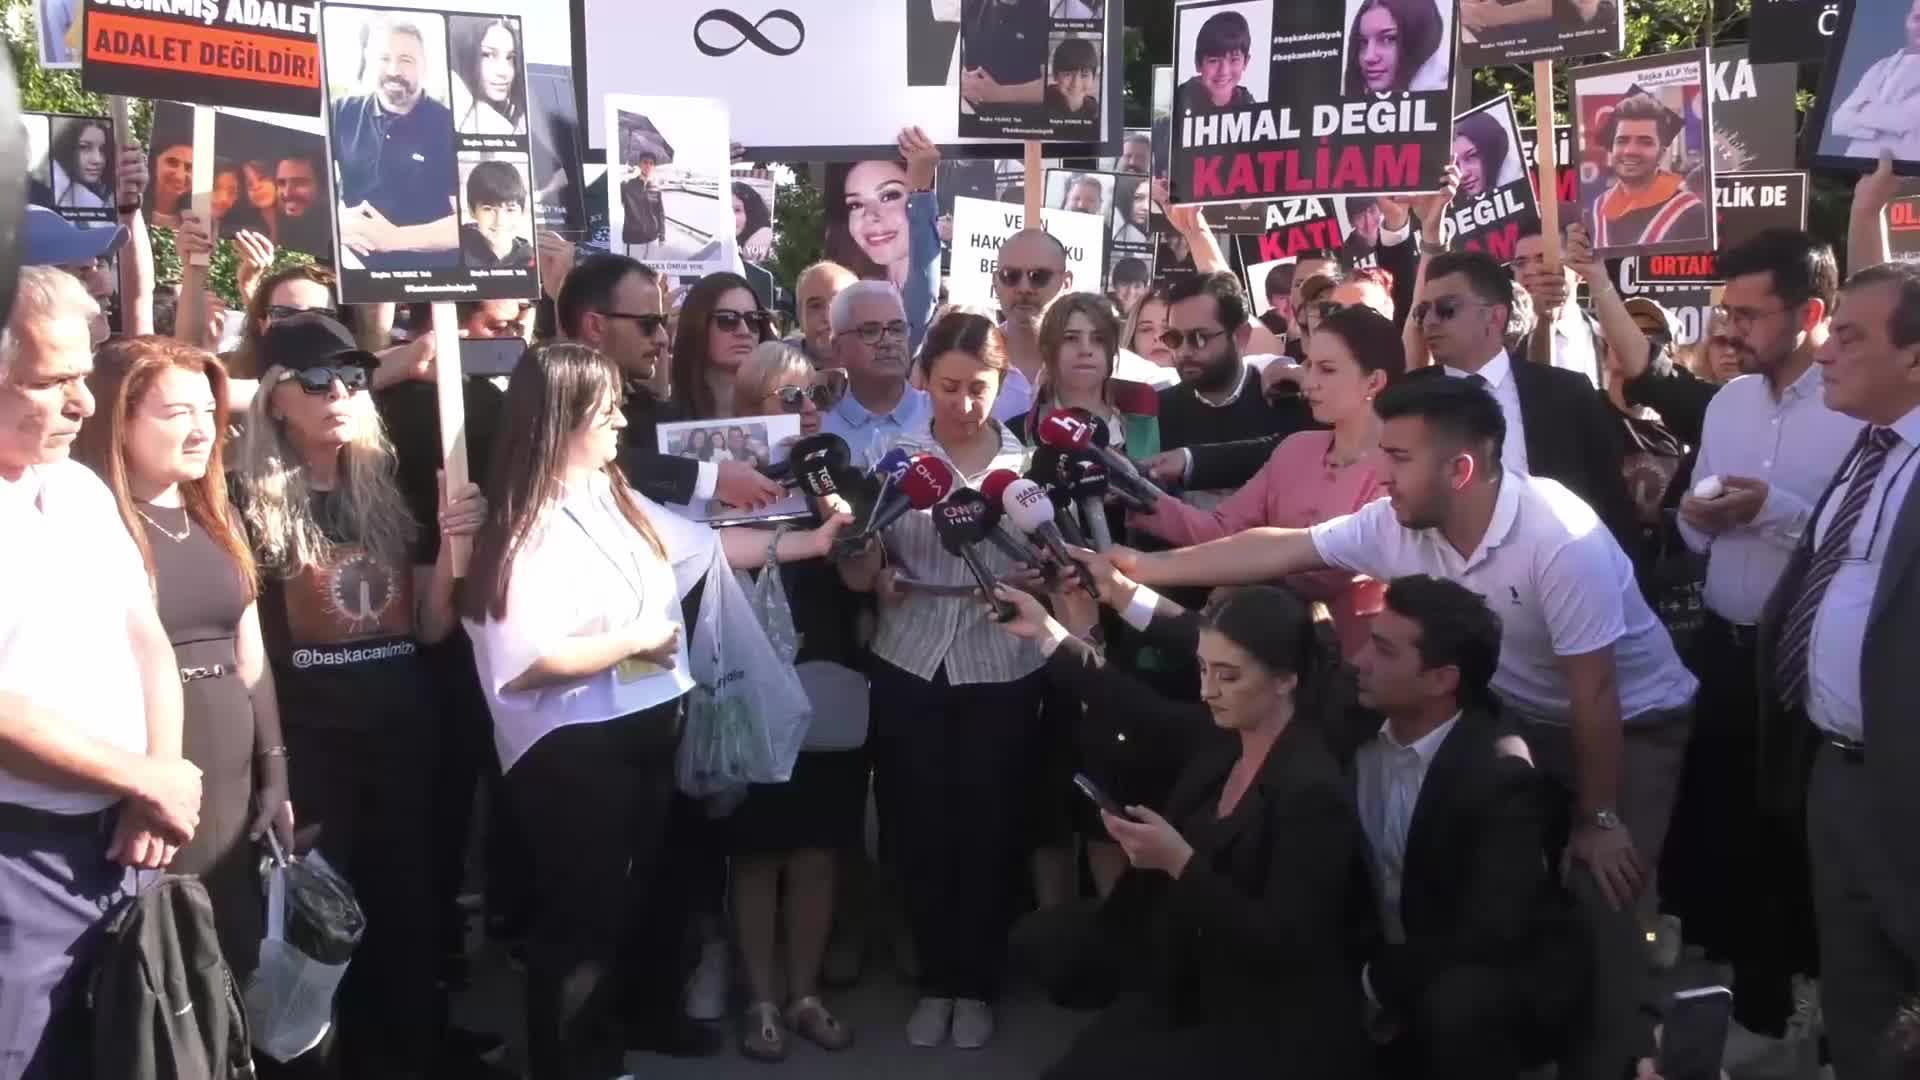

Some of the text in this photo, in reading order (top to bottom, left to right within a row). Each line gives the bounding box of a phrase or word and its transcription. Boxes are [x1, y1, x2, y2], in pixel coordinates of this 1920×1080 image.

[224, 0, 318, 34] ADALET
[95, 29, 314, 79] ADALET DEĞİLDİR!
[1710, 59, 1757, 101] KA
[1182, 91, 1437, 148] İHMAL DEĞİL
[1193, 135, 1422, 199] KATLİAM
[1265, 197, 1326, 230] AZA
[1714, 182, 1787, 207] ZLİK DE
[1004, 213, 1049, 232] VEN
